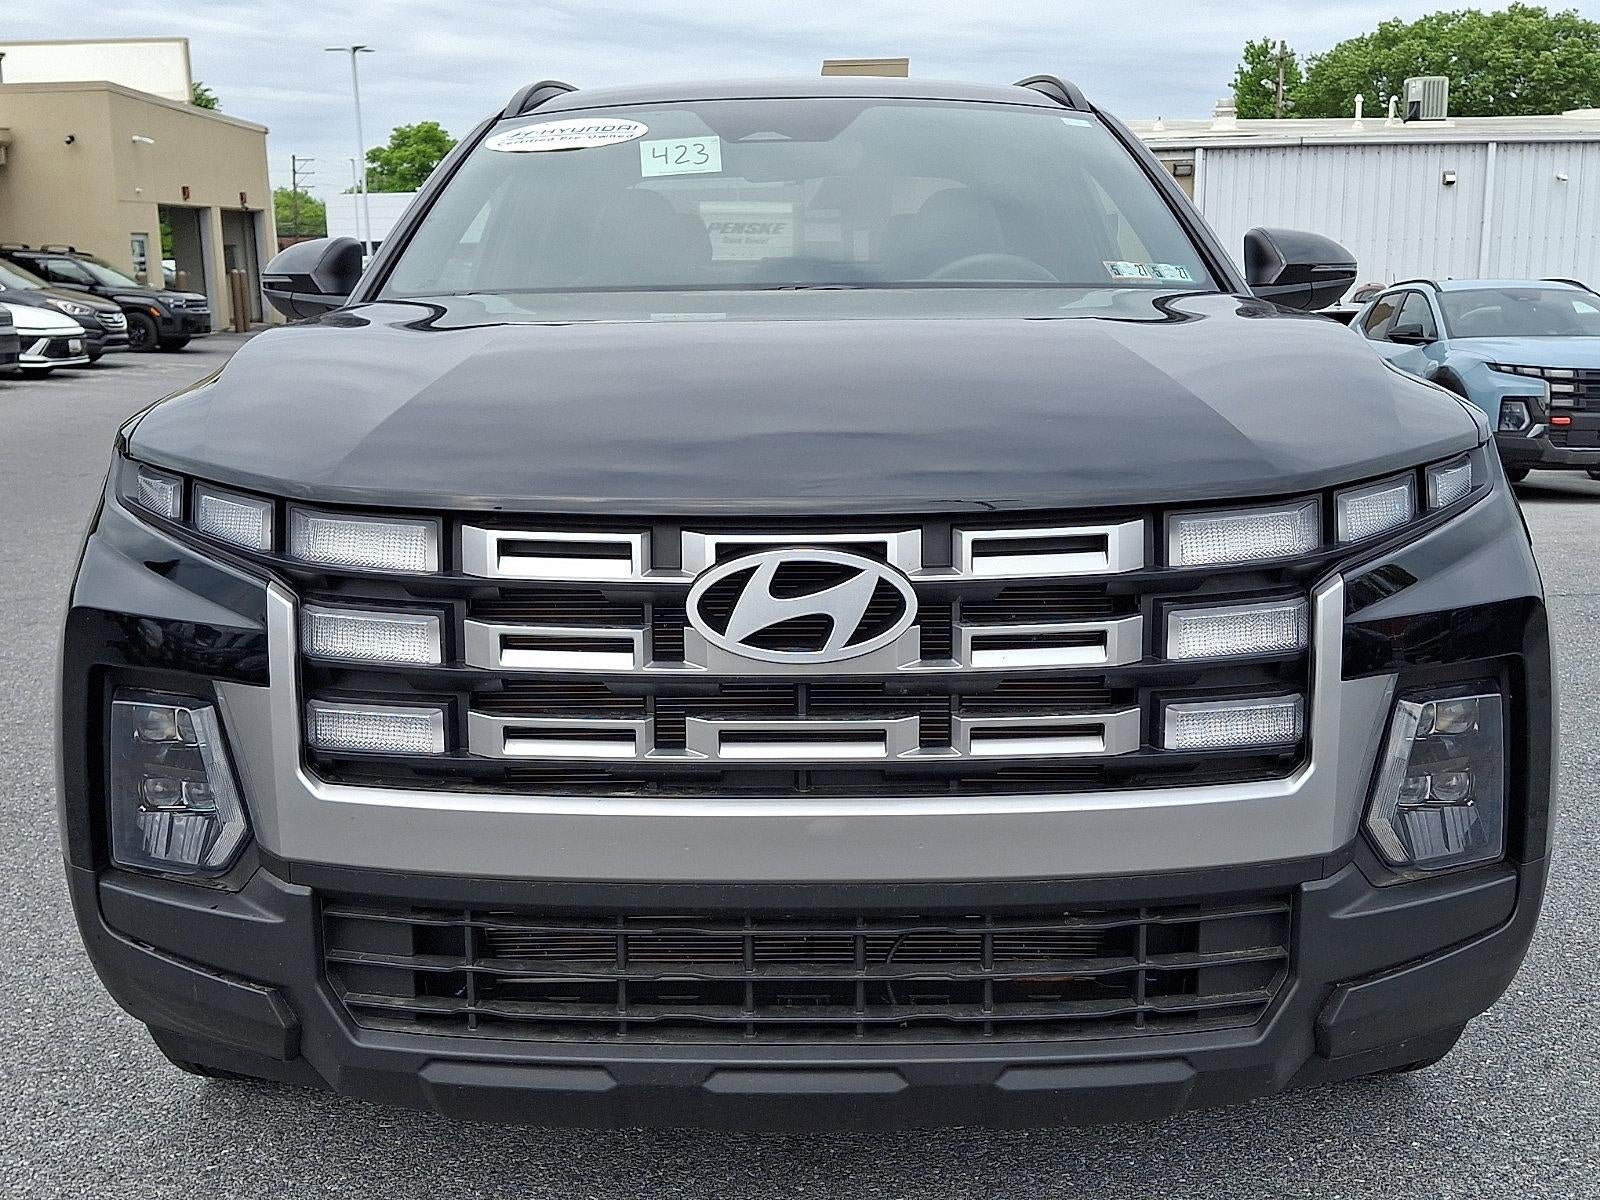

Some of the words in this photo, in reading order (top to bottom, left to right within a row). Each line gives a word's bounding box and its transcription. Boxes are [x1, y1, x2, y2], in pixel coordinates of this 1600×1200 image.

[540, 124, 638, 136] HYUNDAI
[497, 136, 555, 147] Certified
[652, 143, 709, 165] 423
[708, 222, 787, 235] PENSKE
[1110, 264, 1122, 276] 5
[1134, 264, 1149, 277] 27
[1151, 266, 1164, 278] 5
[1174, 266, 1190, 280] 27
